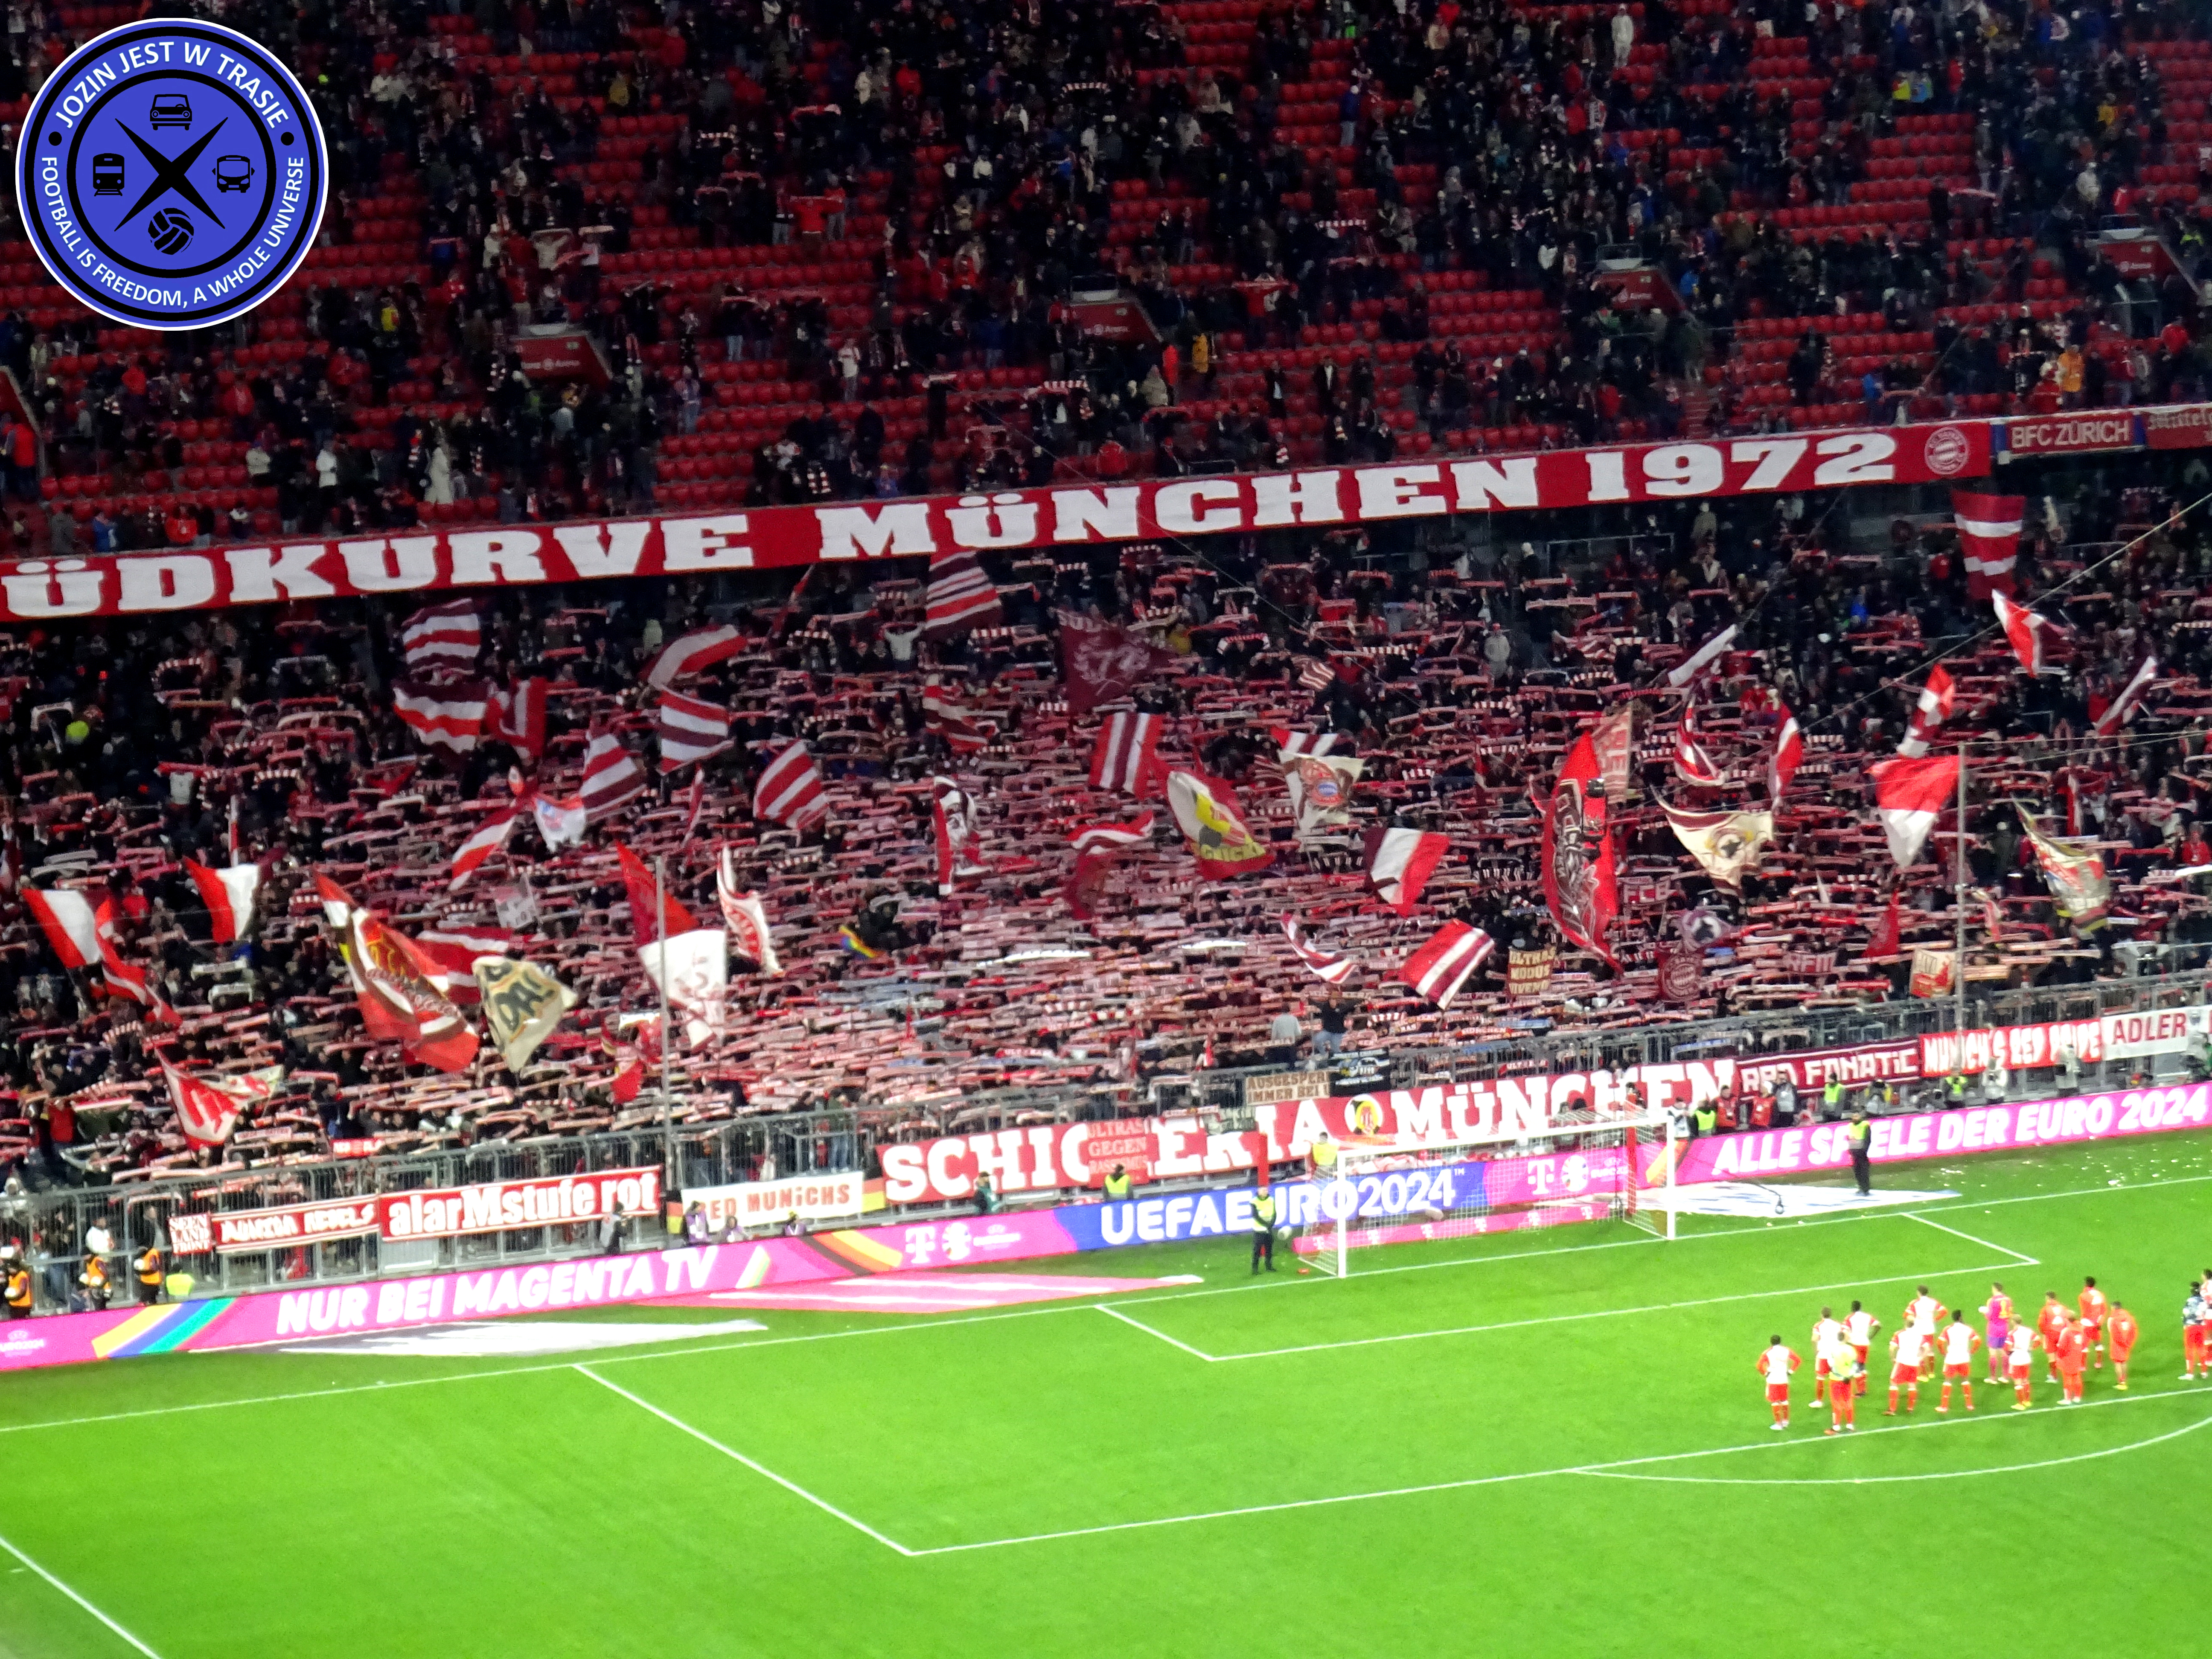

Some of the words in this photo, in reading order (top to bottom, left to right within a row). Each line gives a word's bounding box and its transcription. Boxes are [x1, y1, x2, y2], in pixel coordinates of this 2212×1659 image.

[815, 457, 1538, 559] MÜNCHEN
[1585, 433, 1896, 501] 1972
[2112, 1012, 2187, 1045] ADLER
[883, 1099, 1322, 1200] SCHICERIA
[1390, 1059, 1734, 1143] MÜNCHEN
[1089, 1119, 1144, 1138] ULTRAS
[1712, 1130, 1802, 1176] ALLE
[1809, 1112, 1931, 1163] SPELE
[1937, 1108, 2010, 1158] DER
[2015, 1097, 2112, 1142] EURO
[2118, 1086, 2209, 1130] 2024
[1089, 1137, 1146, 1157] GEGEN
[389, 1178, 597, 1237] alarMstufe
[601, 1172, 657, 1214] rot
[702, 1197, 736, 1220] ED
[169, 1214, 207, 1231] SEEN
[171, 1228, 210, 1243] LAND
[173, 1240, 210, 1254] FRONT
[276, 1288, 369, 1335] NUR
[377, 1280, 445, 1324] BEI
[453, 1254, 654, 1315] MAGENTA
[662, 1244, 719, 1292] TV
